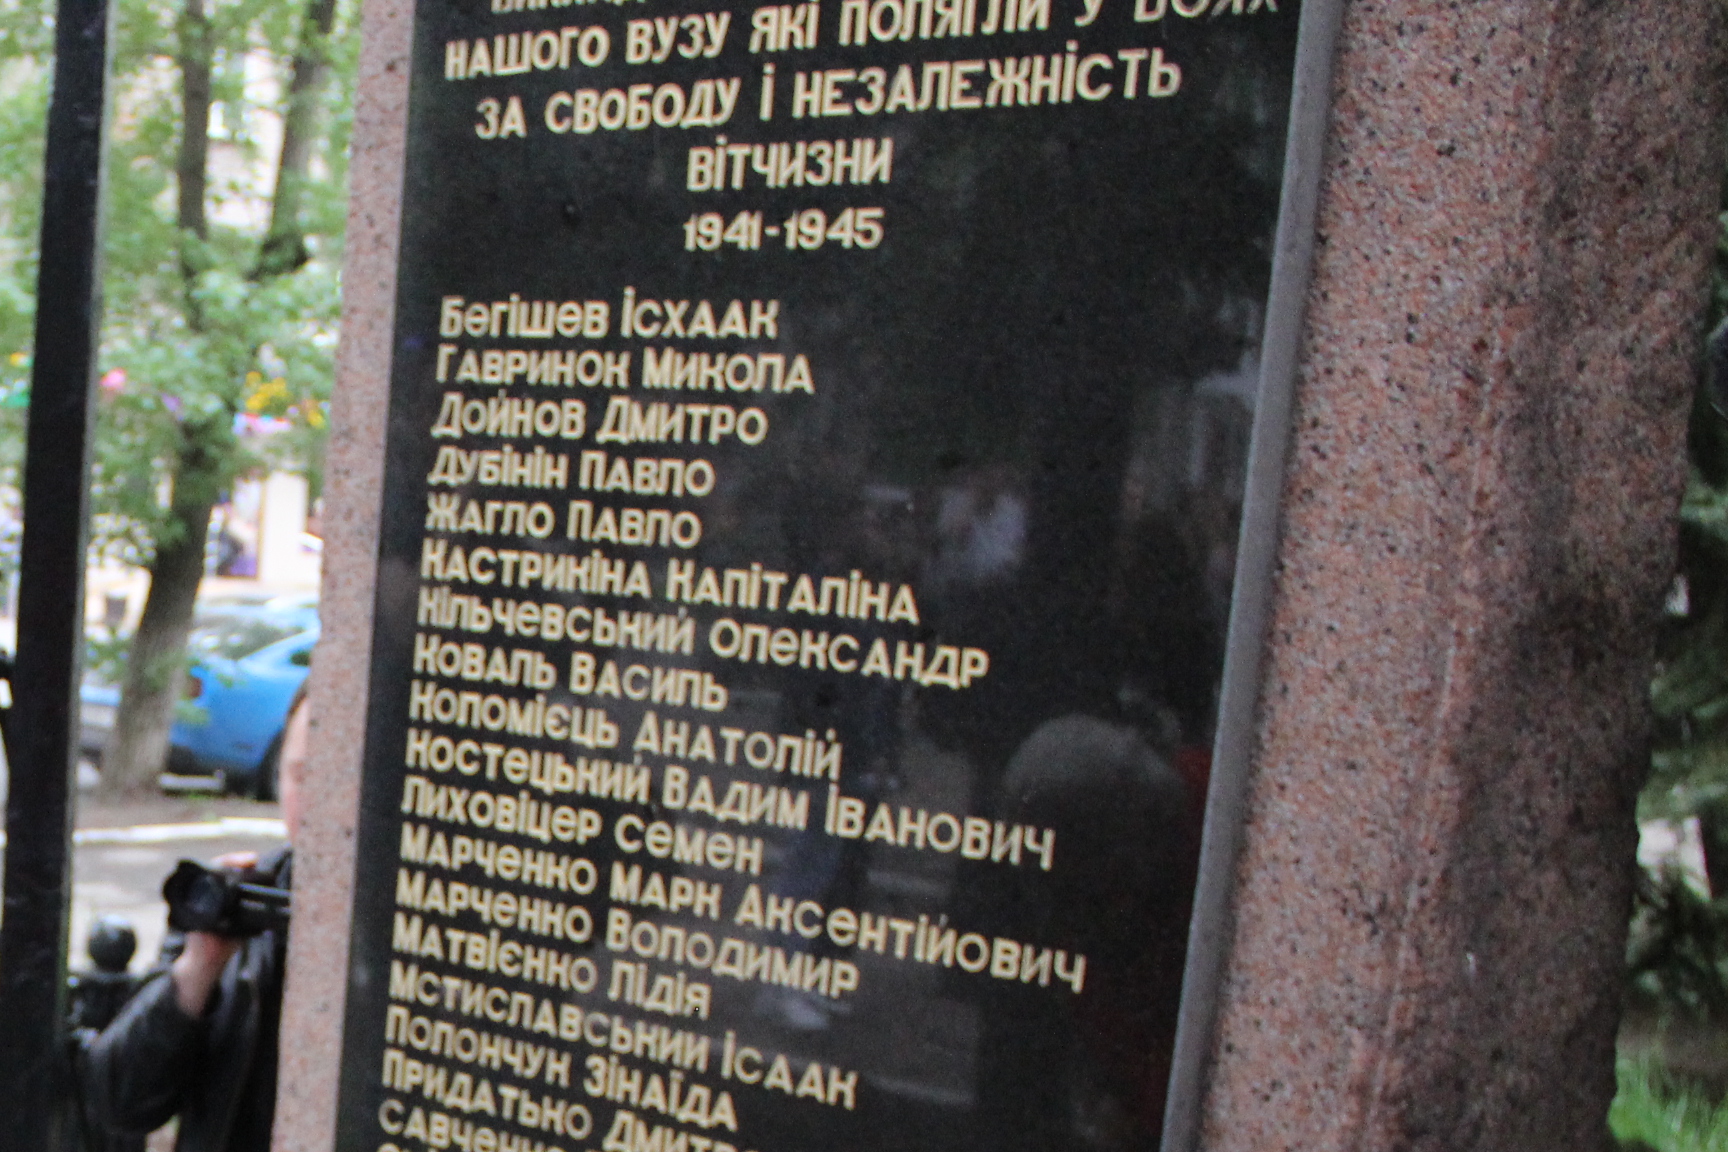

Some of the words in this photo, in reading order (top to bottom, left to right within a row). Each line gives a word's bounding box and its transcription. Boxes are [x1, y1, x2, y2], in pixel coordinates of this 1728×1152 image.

[444, 25, 611, 81] НАШОГО
[625, 11, 731, 64] ВУЗУ
[748, 0, 820, 54] ЯКІ
[474, 96, 527, 140] ЗА
[544, 77, 741, 135] СВОБОДУ
[759, 62, 775, 121] І
[792, 39, 1182, 118] НЕЗАЛЕЖНІСТЬ
[686, 137, 894, 192] ВІТЧИЗНИ
[682, 207, 885, 252] 1941-1945
